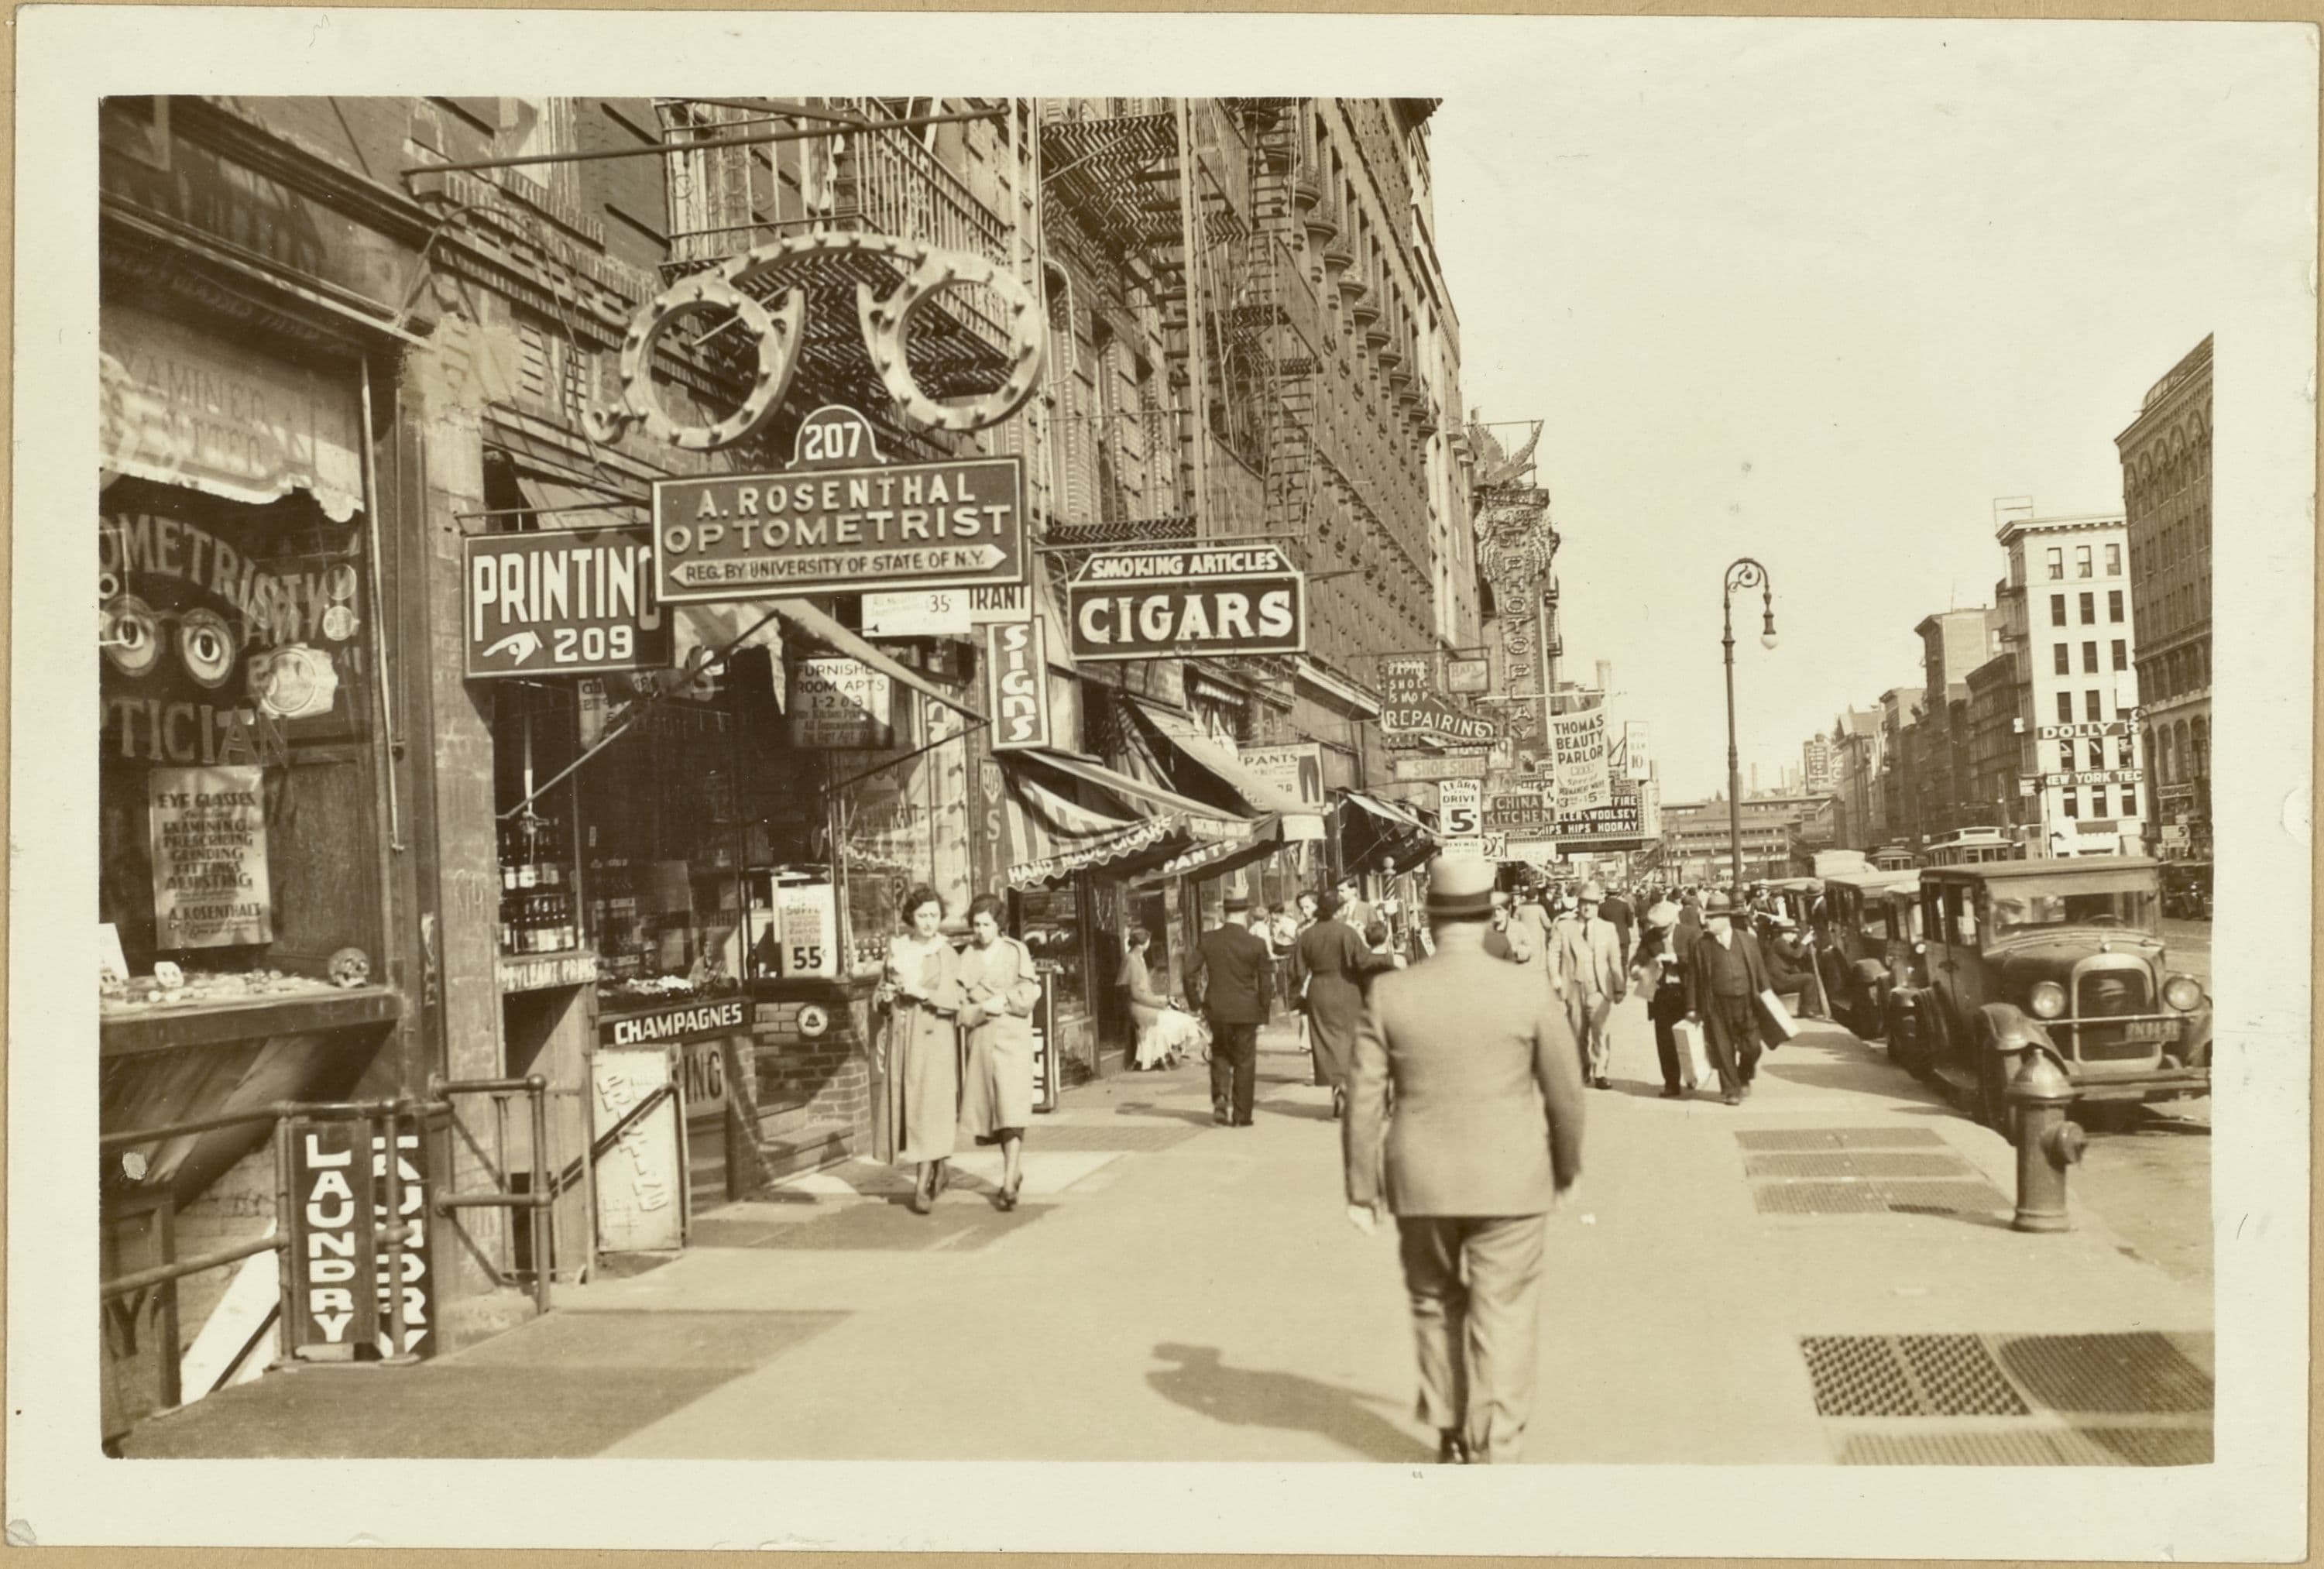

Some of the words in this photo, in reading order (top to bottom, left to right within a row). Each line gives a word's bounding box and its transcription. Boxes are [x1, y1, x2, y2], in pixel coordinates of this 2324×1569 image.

[804, 421, 861, 461] 207
[697, 490, 728, 519] A.
[738, 472, 976, 517] ROSENTHAL
[664, 504, 1011, 554] OPTOMETRIST
[685, 561, 721, 582] REG.
[724, 560, 746, 579] BY
[749, 555, 844, 579] UNIVERSITY
[848, 554, 869, 573] OF
[872, 553, 924, 572] STATE
[928, 551, 950, 570] OF
[953, 548, 985, 568] N.Y.
[1091, 555, 1183, 579] SMOKING
[1188, 551, 1279, 575] ARTICLES
[1079, 589, 1293, 645] CIGARS
[553, 625, 634, 663] 209
[794, 663, 874, 678] FURNISHE
[843, 678, 885, 692] APTS
[1002, 624, 1036, 743] SIGNS
[1385, 709, 1488, 739] REPAIRING
[1553, 713, 1605, 735] THOMAS
[2042, 722, 2113, 738] DOLLY
[1557, 729, 1605, 750] BEAUTY
[1244, 754, 1298, 767] PANTS
[1558, 744, 1604, 765] PARLOR
[1414, 761, 1446, 776] SHOE
[1449, 760, 1485, 775] SHINE
[2075, 771, 2112, 784] YORK
[2116, 770, 2144, 782] TEC
[1443, 780, 1478, 791] LEARN
[1443, 795, 1475, 803] DRIVE
[1496, 797, 1540, 810] CHINA
[1487, 810, 1551, 824] KITCHEN
[1590, 809, 1637, 821] WOOLSEY
[1568, 822, 1591, 834] HIPS
[1598, 821, 1638, 833] HOORAY
[1162, 840, 1238, 874] PANTS
[1008, 859, 1054, 883] HAND
[614, 1003, 743, 1045] CHAMPAGNES
[304, 1134, 355, 1343] LAUNDRY
